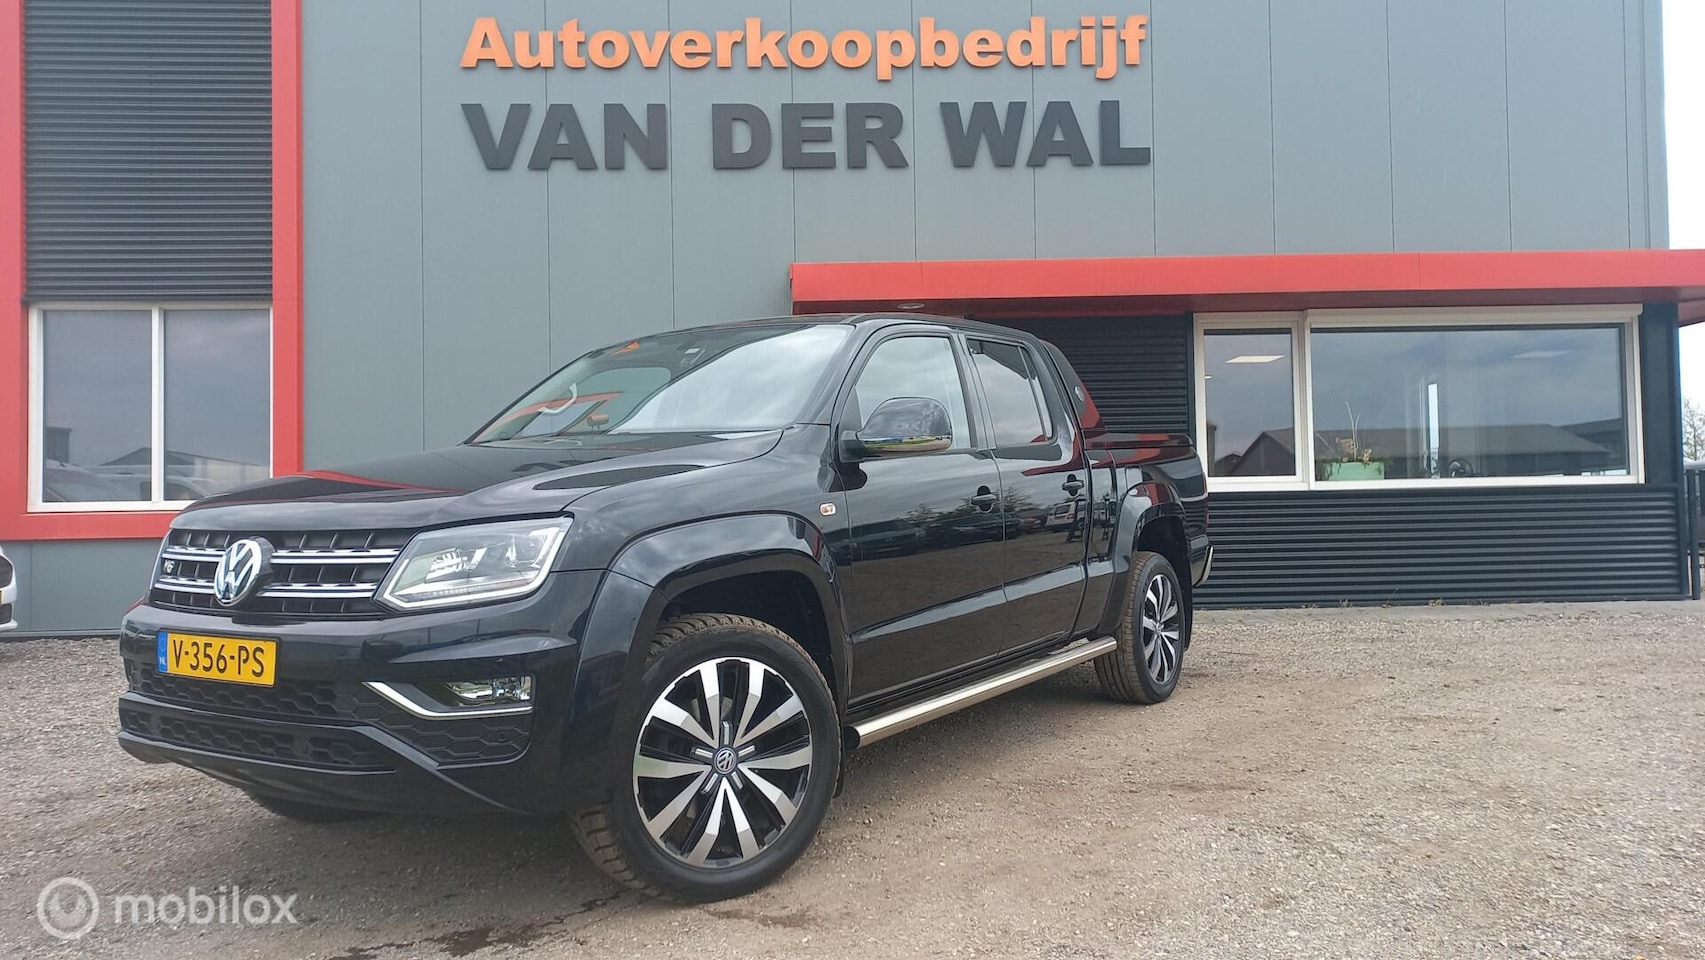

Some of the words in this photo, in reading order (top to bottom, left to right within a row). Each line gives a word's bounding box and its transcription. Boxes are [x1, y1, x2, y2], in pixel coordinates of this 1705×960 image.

[460, 15, 1148, 81] Autoverkoopbedrijf
[460, 103, 668, 172] VAN
[711, 102, 910, 171] DER
[939, 100, 1151, 169] WAL
[172, 639, 265, 678] V-356-PS
